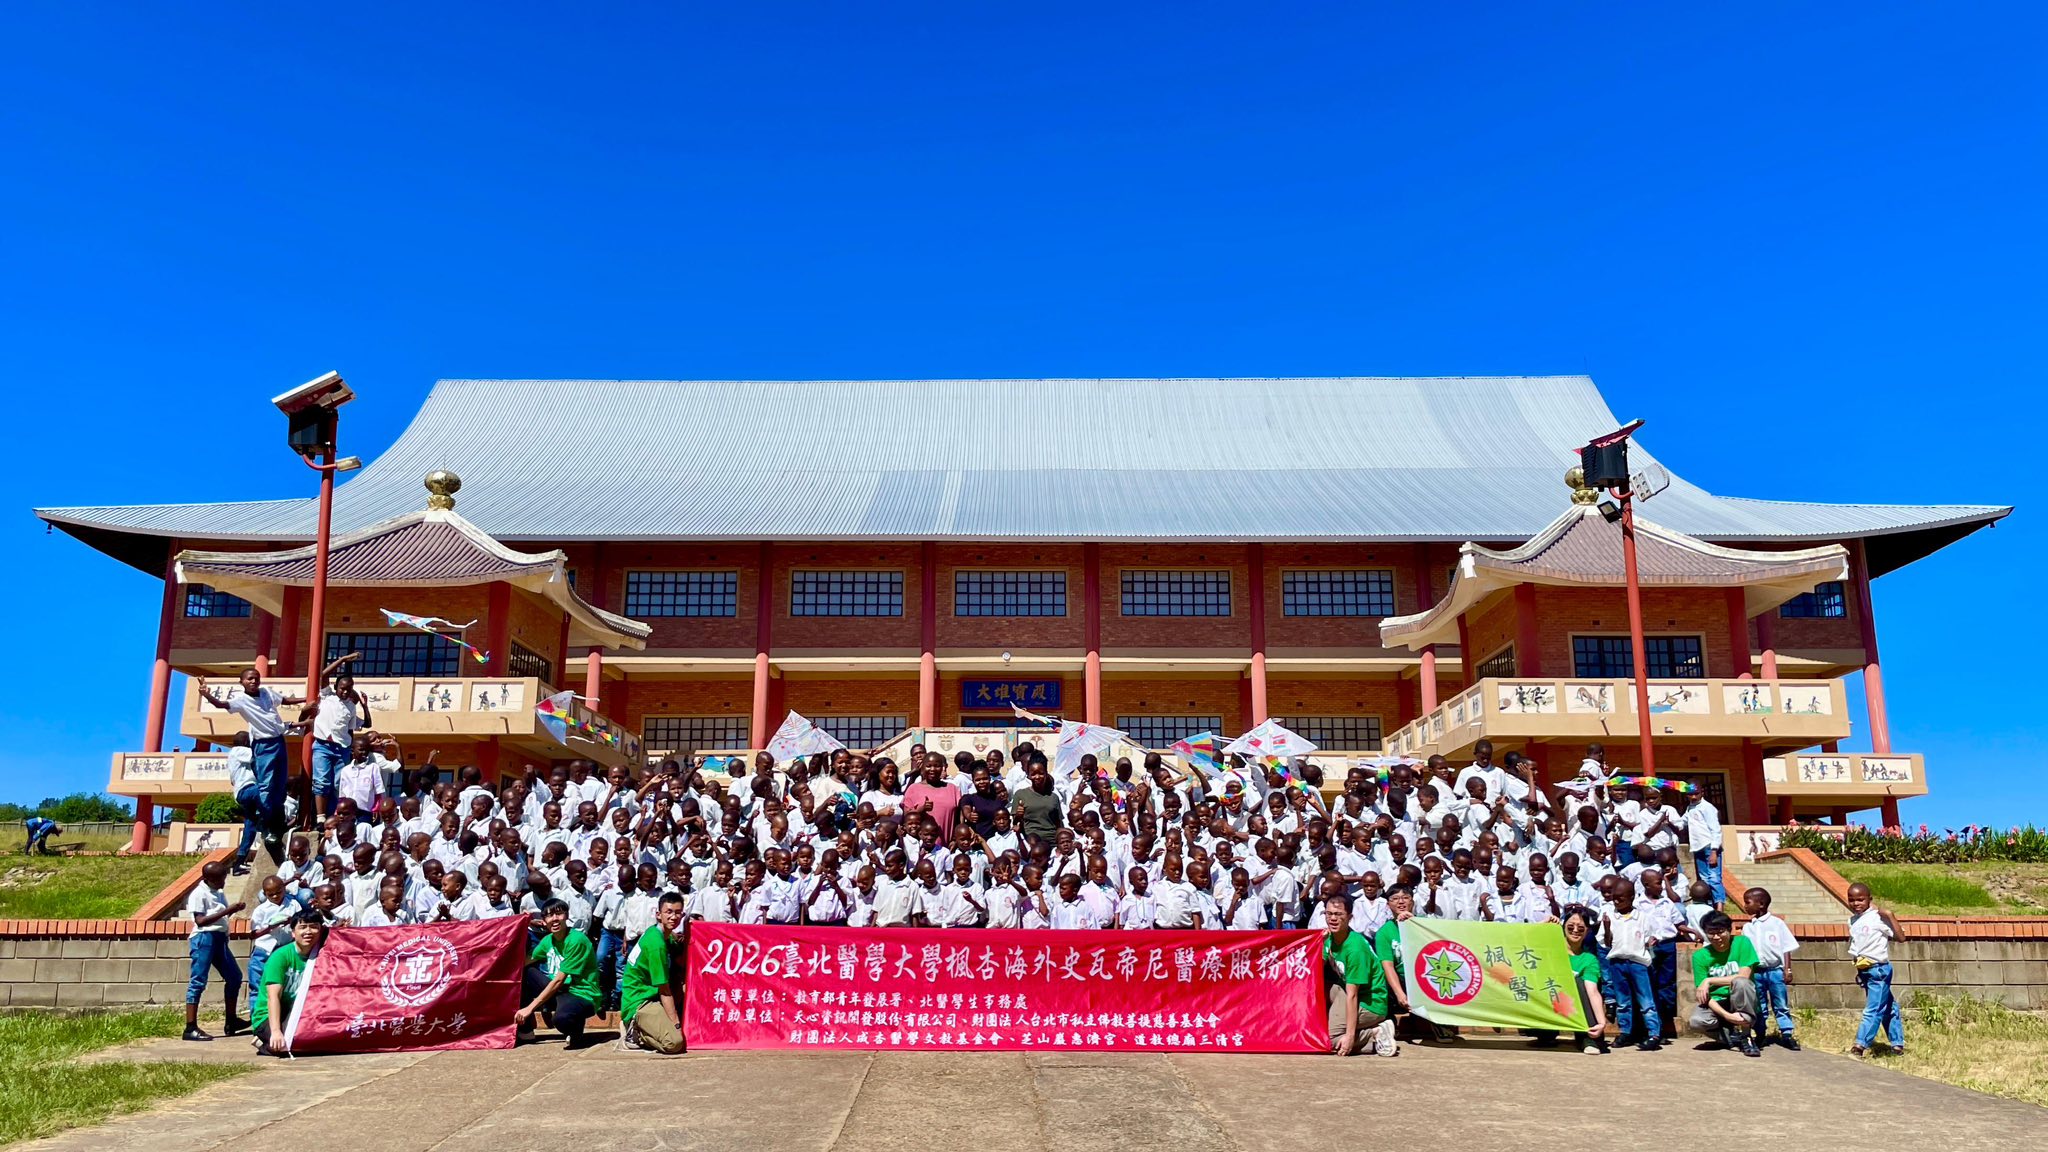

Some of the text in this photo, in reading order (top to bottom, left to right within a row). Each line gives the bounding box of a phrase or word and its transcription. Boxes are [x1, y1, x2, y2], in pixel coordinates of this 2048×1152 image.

[977, 683, 1047, 701] 大雄寶殿
[397, 935, 430, 950] MEDICAL
[433, 936, 459, 966] UNIVERSITY
[1484, 944, 1542, 969] 楓杏
[1508, 976, 1562, 1003] 醫青
